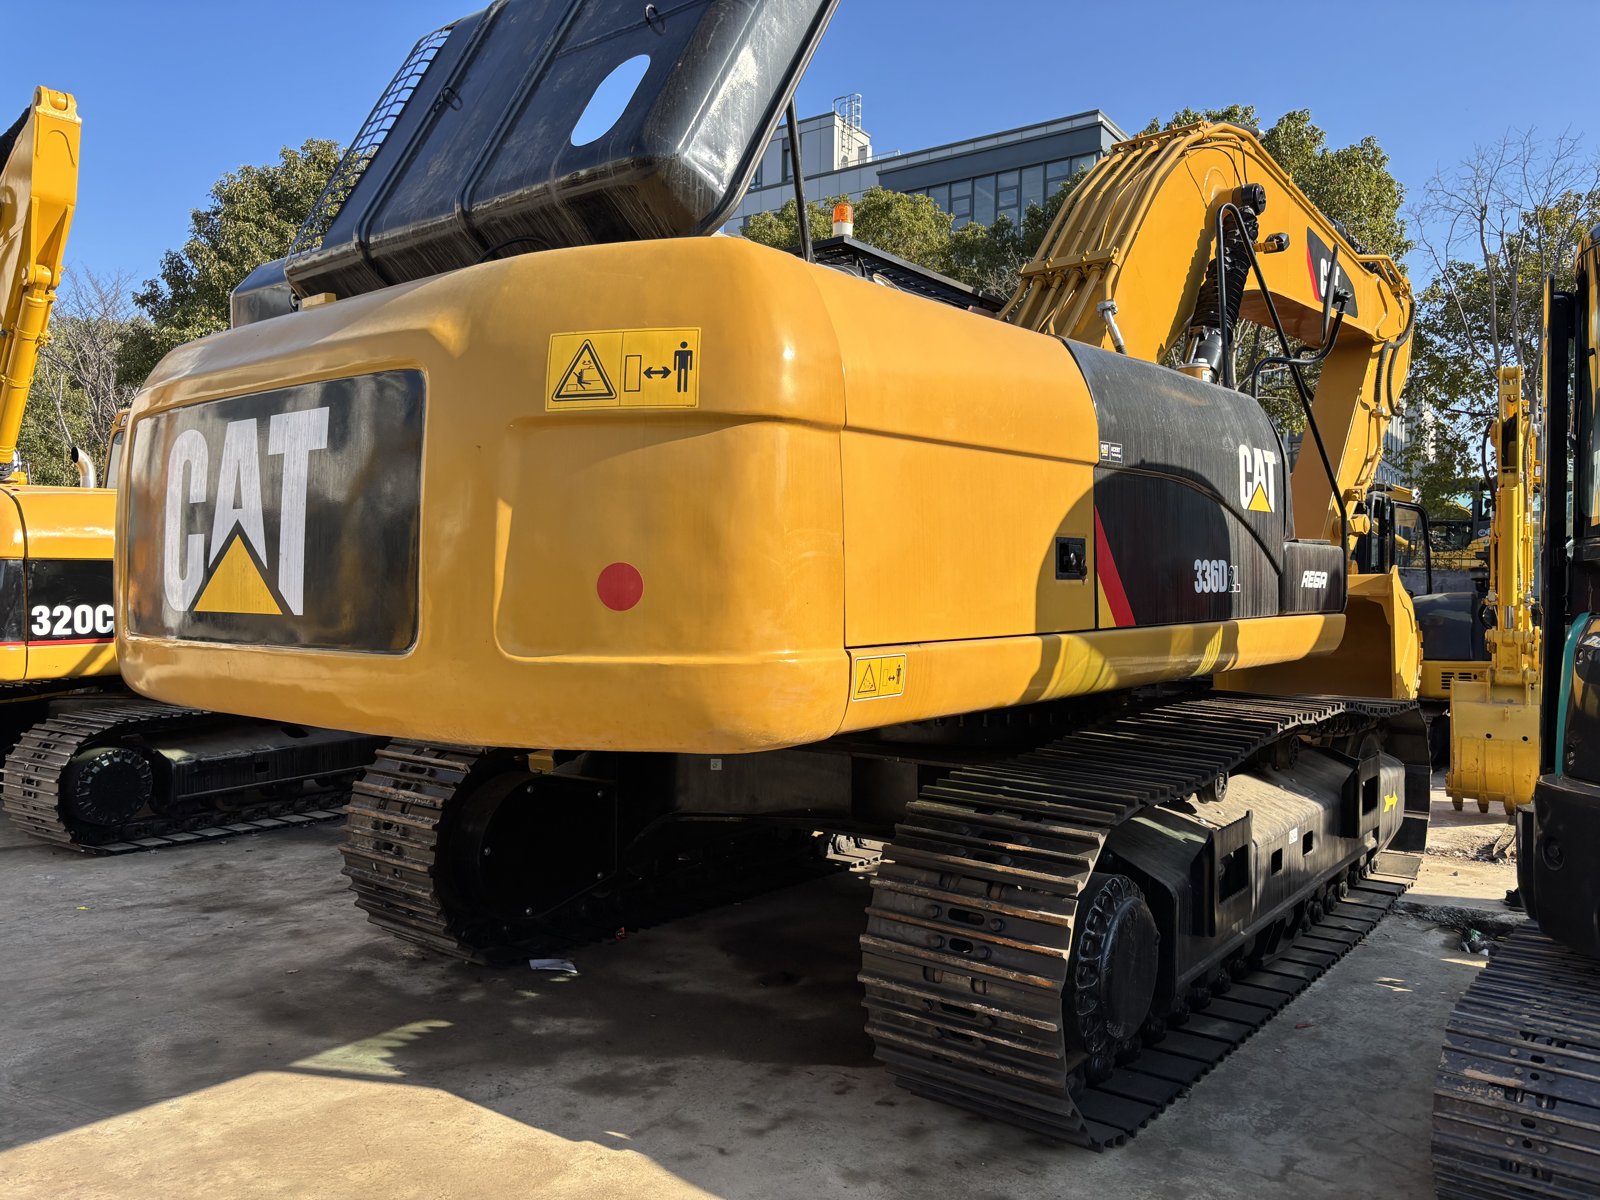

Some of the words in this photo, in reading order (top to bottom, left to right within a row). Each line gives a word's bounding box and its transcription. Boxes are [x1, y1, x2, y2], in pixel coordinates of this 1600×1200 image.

[163, 406, 329, 616] CAT
[1239, 445, 1276, 513] CAT
[31, 604, 114, 636] 320C
